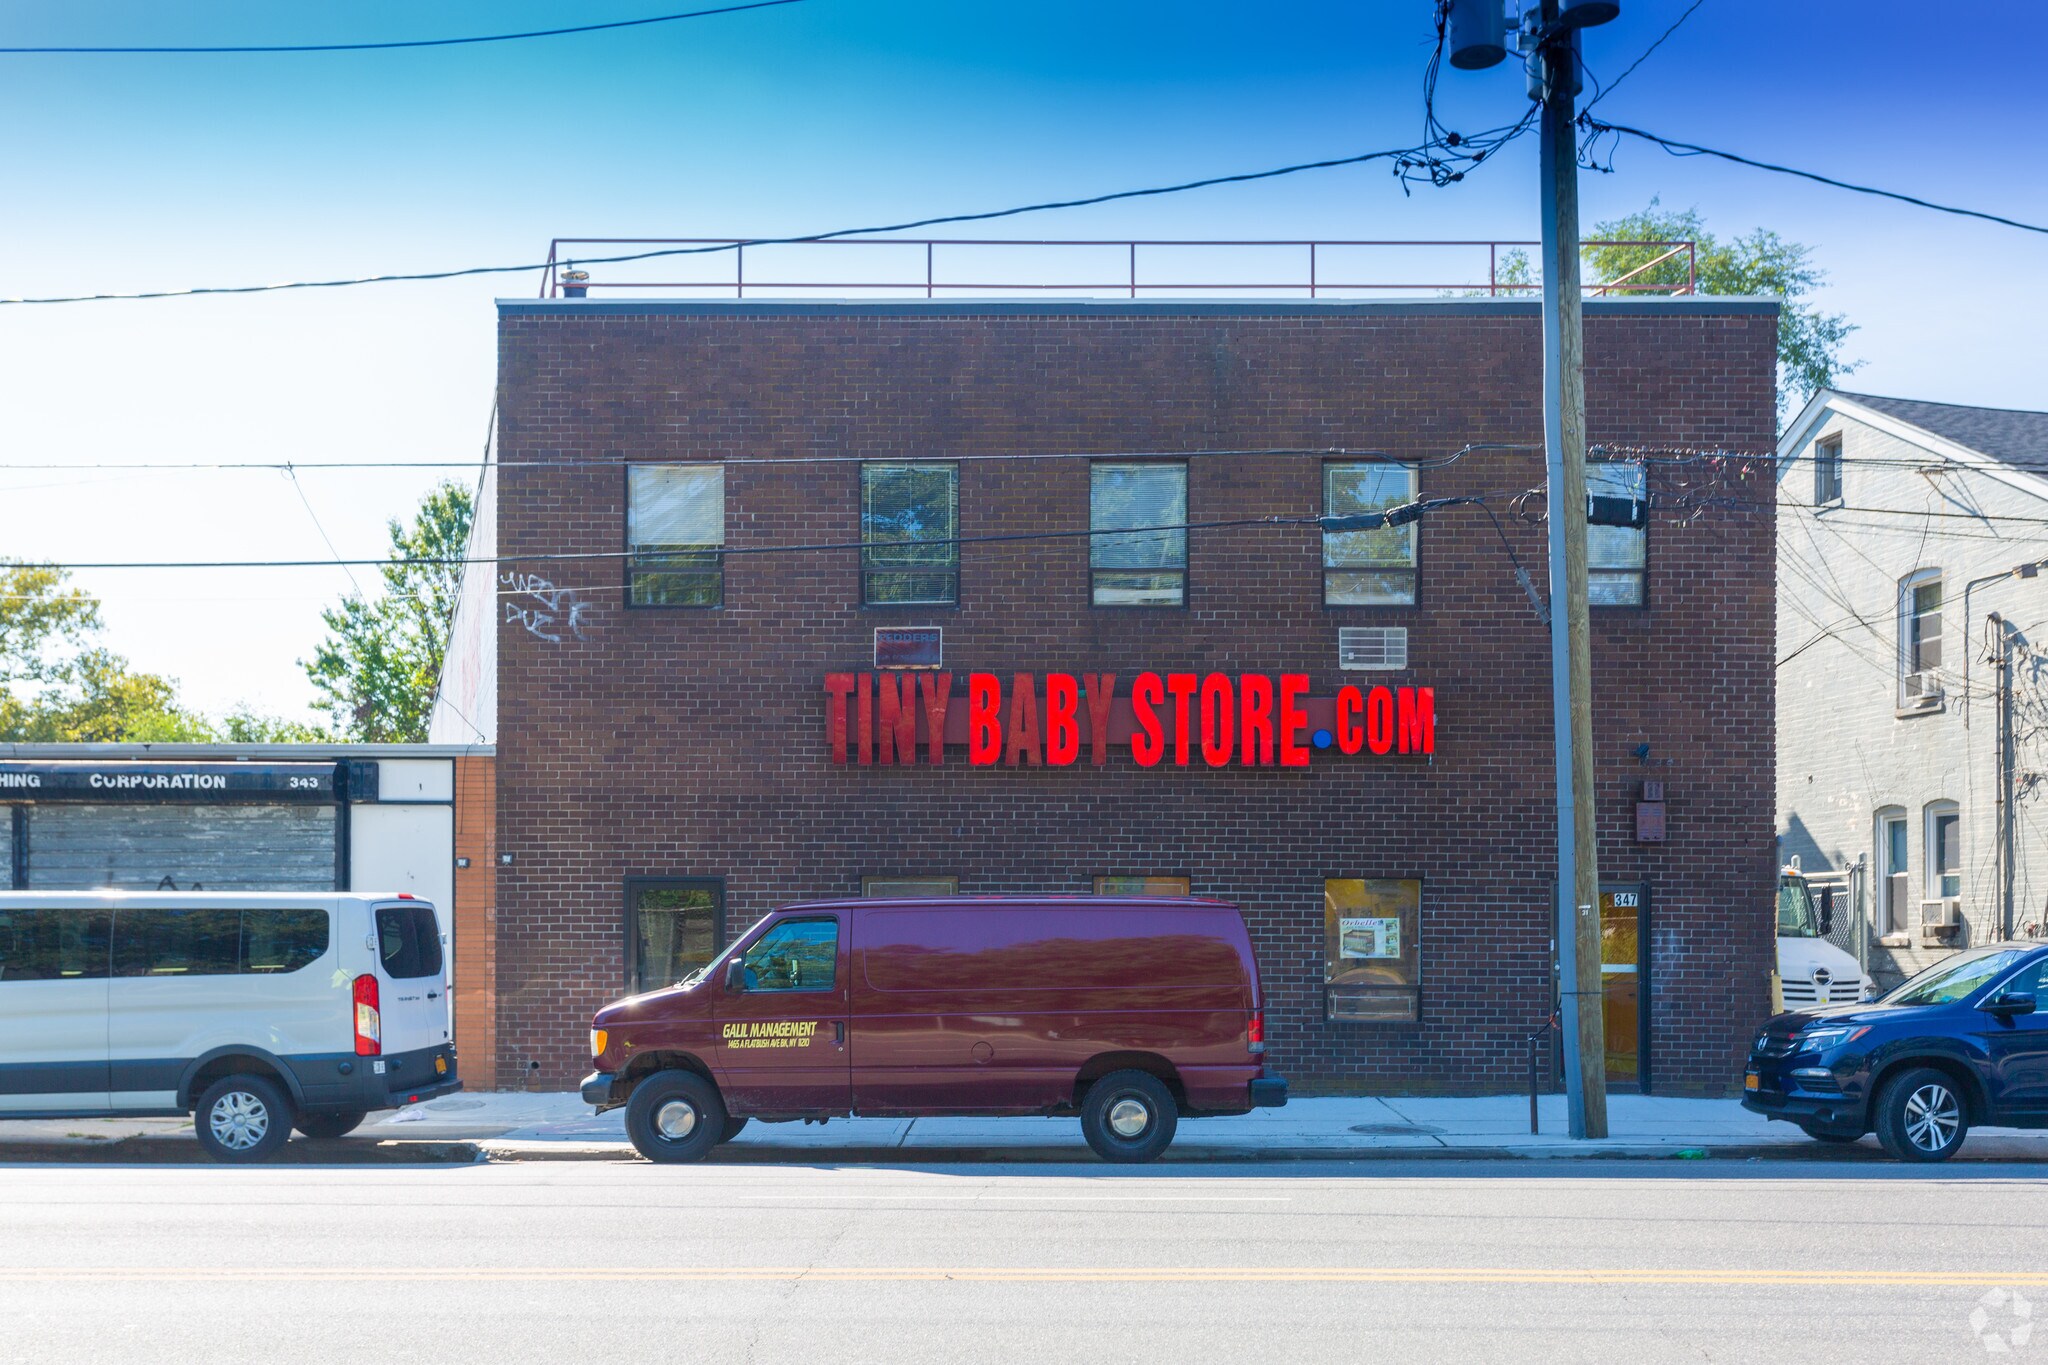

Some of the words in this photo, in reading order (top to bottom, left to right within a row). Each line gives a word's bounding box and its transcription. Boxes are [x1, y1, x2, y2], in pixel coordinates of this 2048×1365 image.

[824, 673, 953, 767] TINY
[969, 673, 1117, 767] BABY
[89, 773, 226, 788] CORPORATION
[290, 776, 319, 788] 343
[1615, 894, 1637, 906] 347
[722, 1023, 749, 1039] GALIL
[749, 1021, 818, 1037] MANAGEMENT
[745, 1038, 770, 1049] FLATBUSH
[770, 1038, 780, 1048] AVE
[789, 1038, 798, 1048] NY
